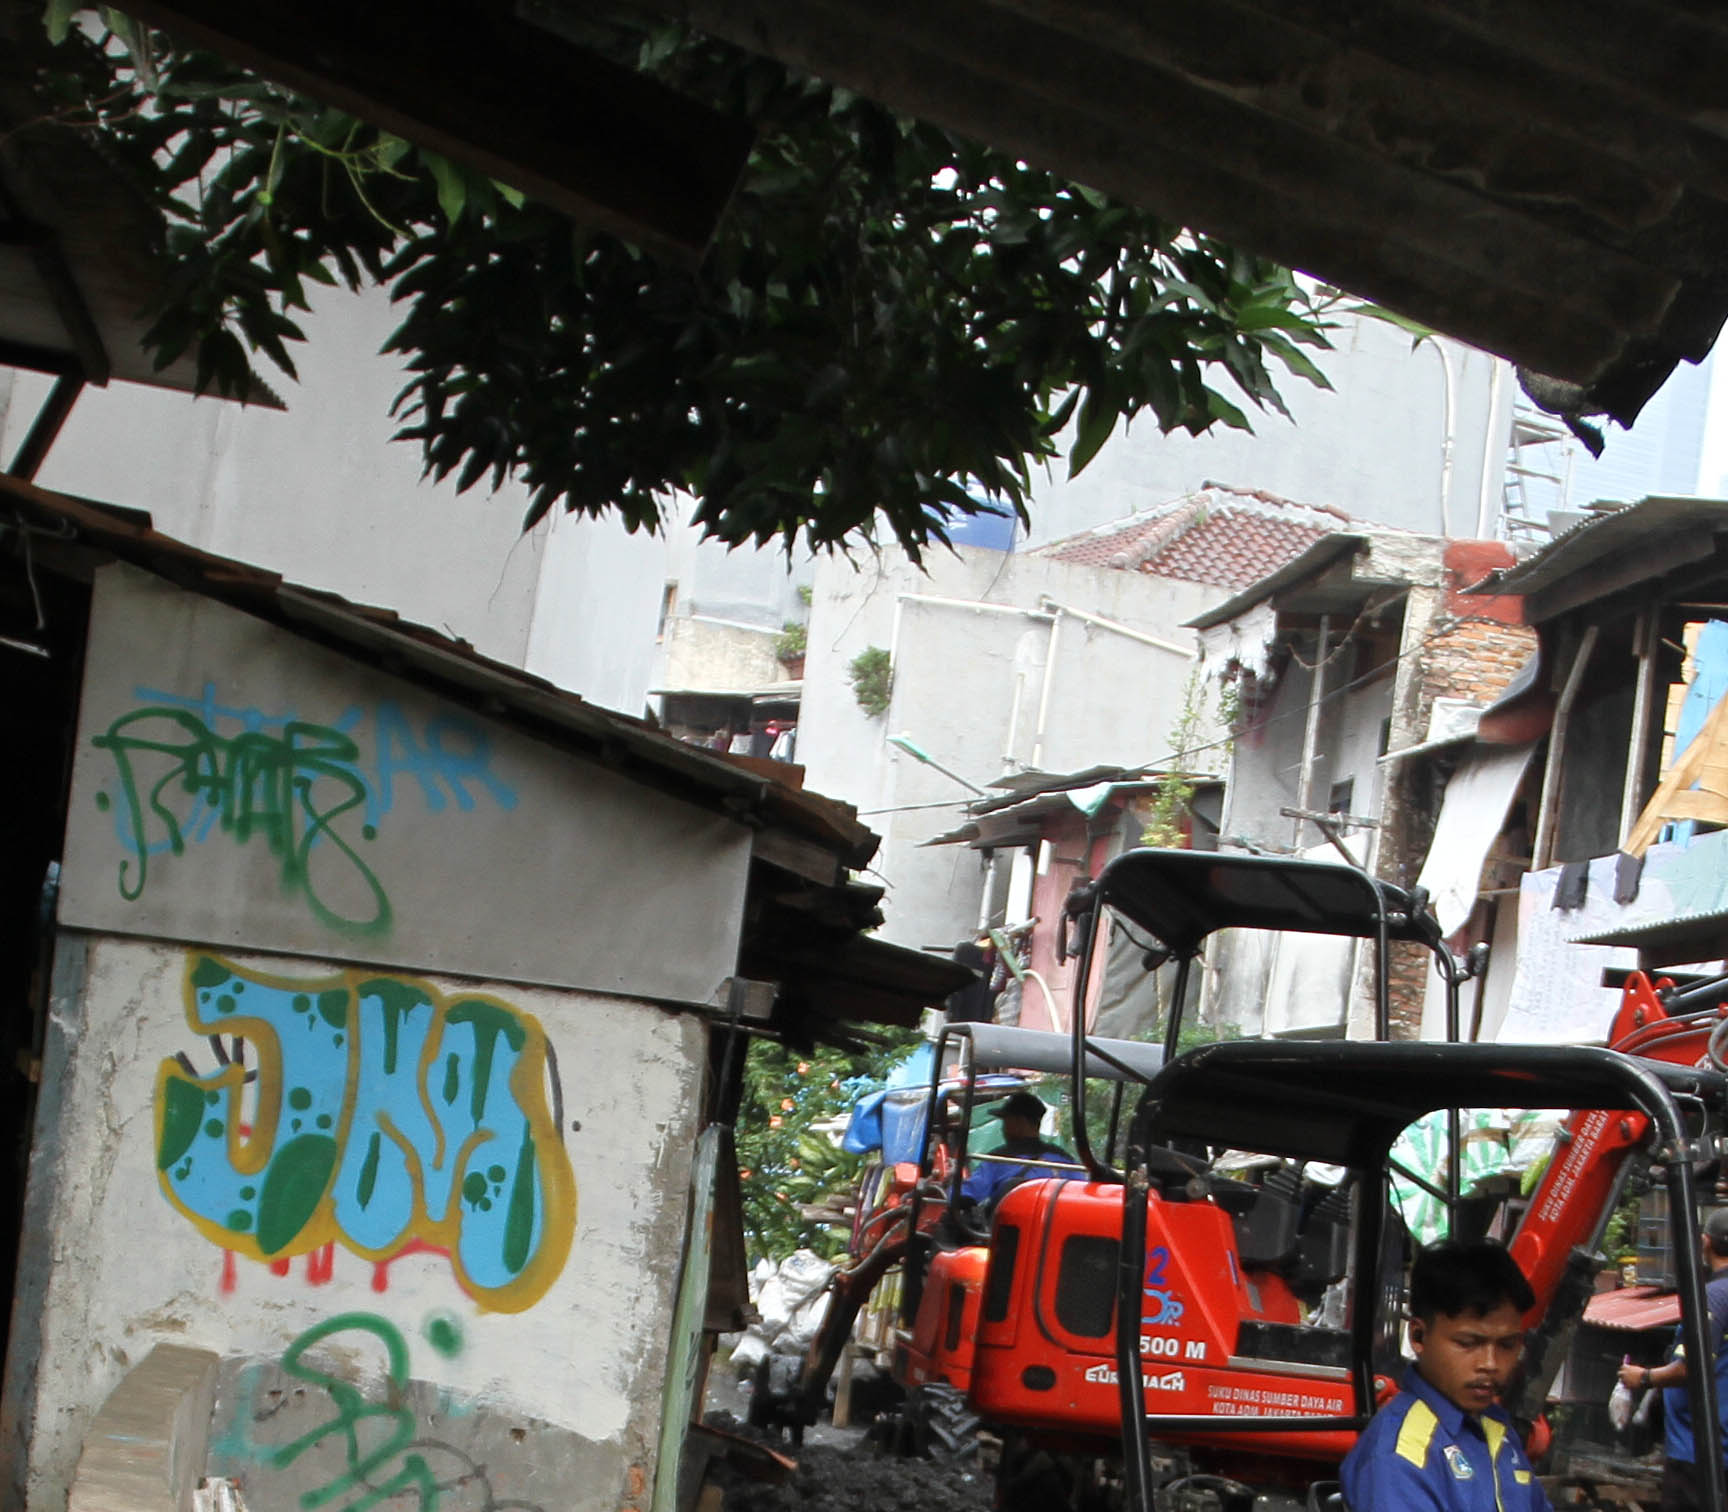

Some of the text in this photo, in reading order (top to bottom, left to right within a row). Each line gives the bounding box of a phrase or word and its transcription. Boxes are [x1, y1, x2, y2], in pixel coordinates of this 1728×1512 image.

[1144, 1246, 1170, 1286] 2
[1138, 1335, 1206, 1360] 500 M
[1084, 1363, 1185, 1392] EURACH
